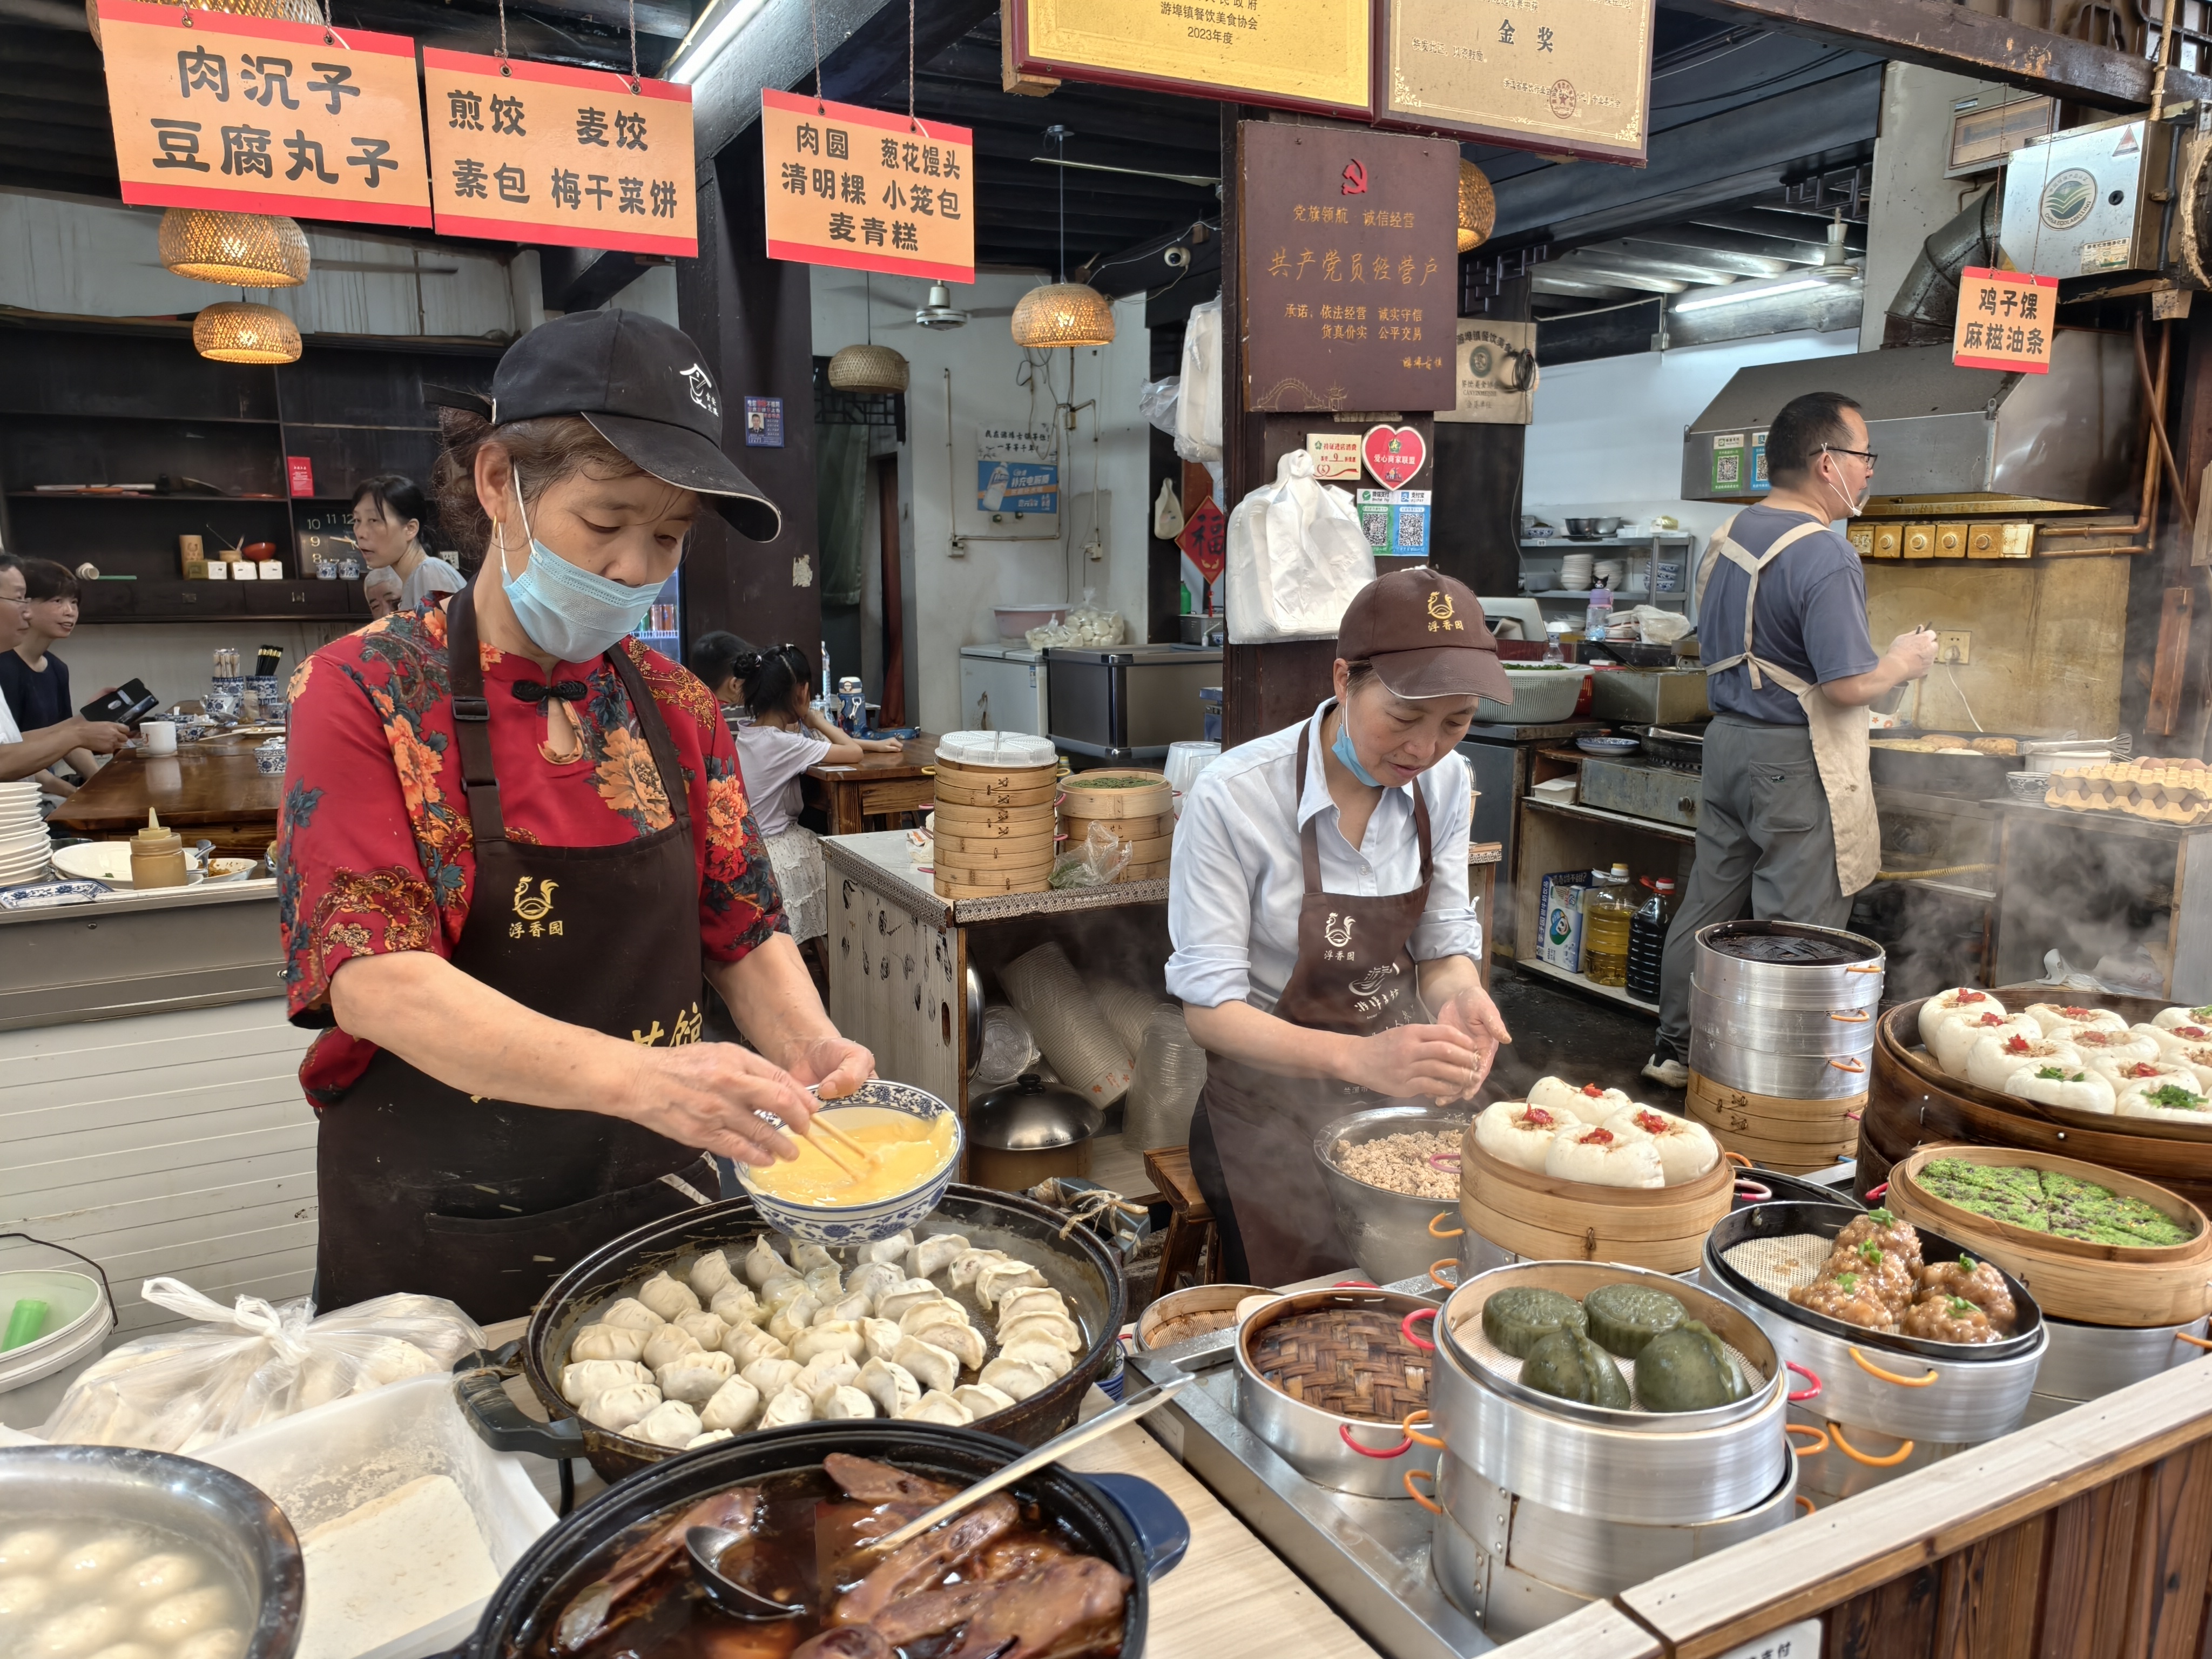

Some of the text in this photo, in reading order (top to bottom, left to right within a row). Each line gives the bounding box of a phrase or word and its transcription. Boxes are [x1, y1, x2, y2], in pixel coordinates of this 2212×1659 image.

[1161, 1, 1258, 30] 游埠镇餐饮美食协会
[1188, 26, 1233, 45] 2023年度
[178, 45, 360, 115] 肉沉子
[447, 89, 648, 152] 煎饺 麦饺
[151, 118, 398, 188] 豆腐丸子
[797, 123, 960, 180] 肉圆 葱花馒头
[453, 158, 677, 219] 素包 梅干菜饼
[781, 162, 961, 220] 清明粿 小笼包
[1293, 204, 1415, 228] 党旗领航 诚信经营
[829, 212, 918, 252] 麦青糕
[1267, 246, 1438, 286] 共产党员经营户
[1320, 304, 1366, 320] 依法经营
[1378, 307, 1422, 322] 诚实守信
[1321, 324, 1422, 341] 货真价实 公平交易
[1963, 321, 2045, 355] 麻糍油条
[1333, 454, 1338, 462] 9
[1373, 454, 1415, 465] 爱心商家联盟
[307, 518, 321, 530] 10
[327, 514, 336, 524] 11
[311, 536, 320, 547] 9
[1191, 514, 1225, 557] 福
[509, 920, 563, 939] 浮香园
